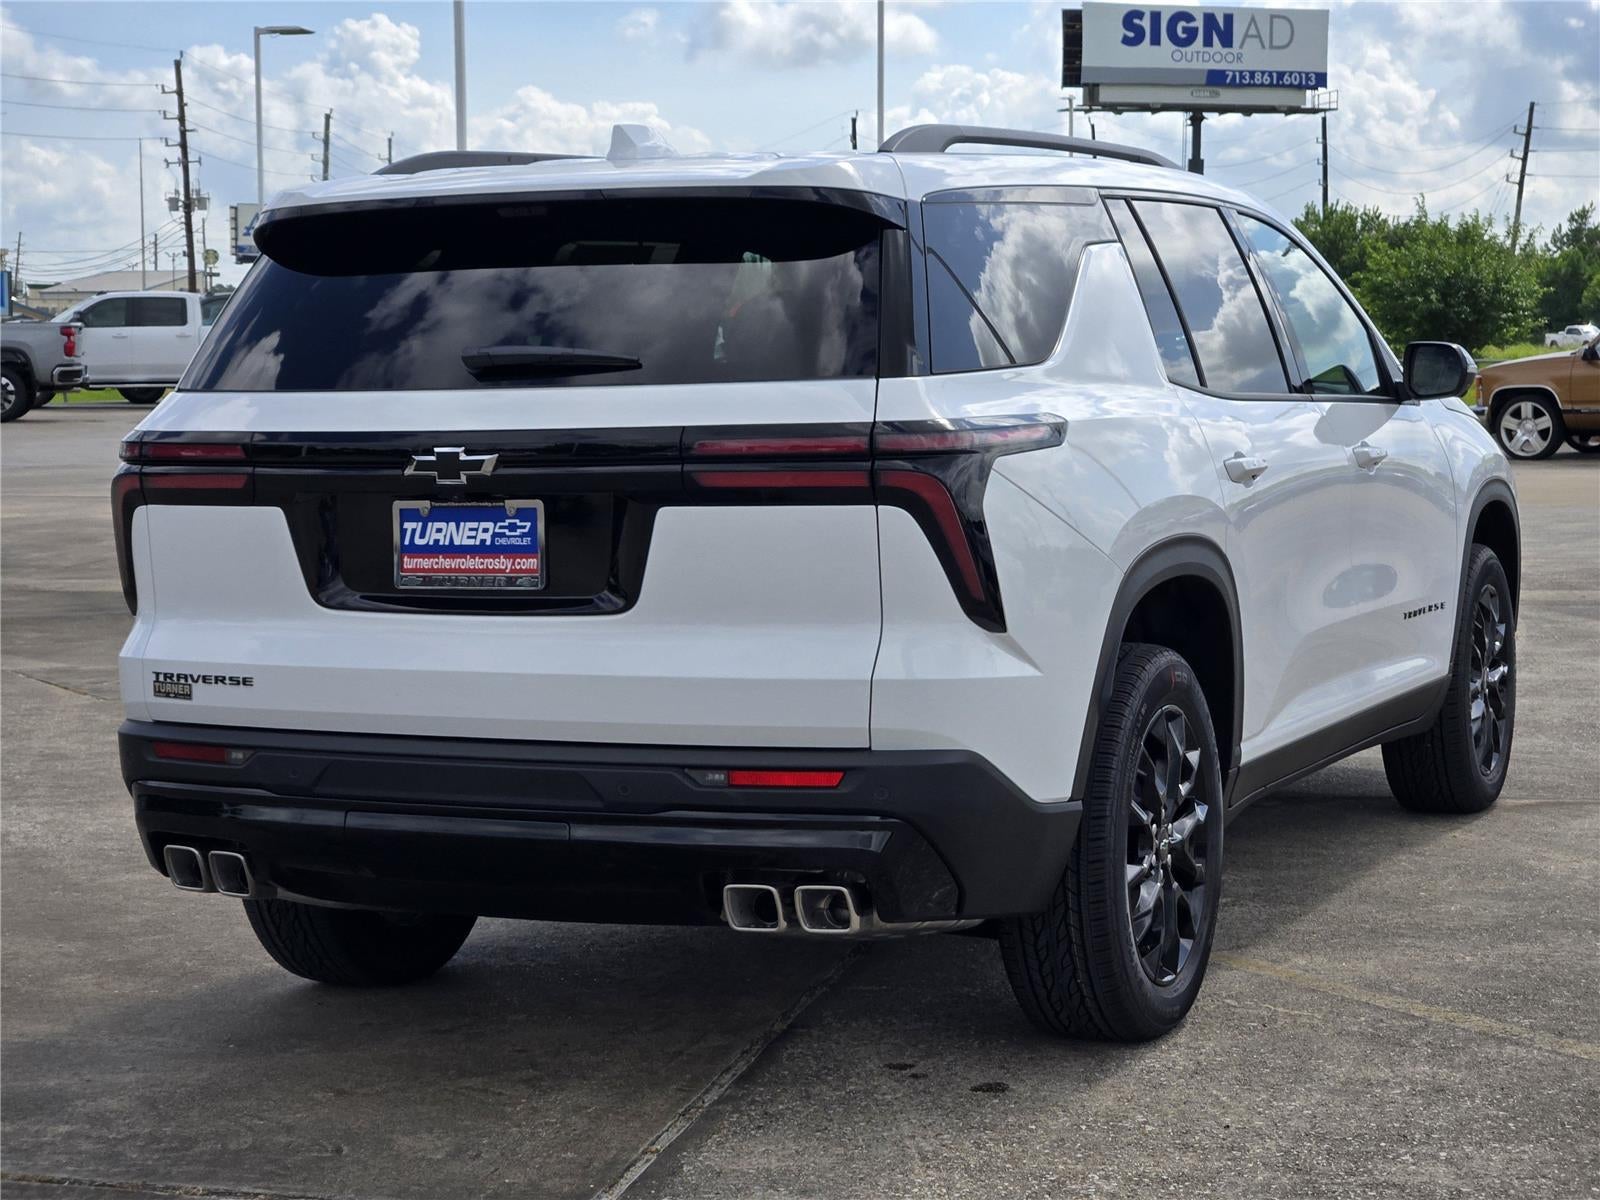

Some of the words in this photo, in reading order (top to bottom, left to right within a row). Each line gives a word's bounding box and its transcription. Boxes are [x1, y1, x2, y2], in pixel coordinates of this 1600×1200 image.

[1171, 49, 1244, 65] OUTDOOR
[1225, 71, 1317, 86] 713.861.6013
[403, 522, 494, 545] TURNER
[494, 537, 532, 545] CHEVROLET
[403, 555, 538, 573] turnerchevroletcrosby.com
[152, 671, 254, 686] TRAVERSE
[155, 682, 191, 695] TURNER
